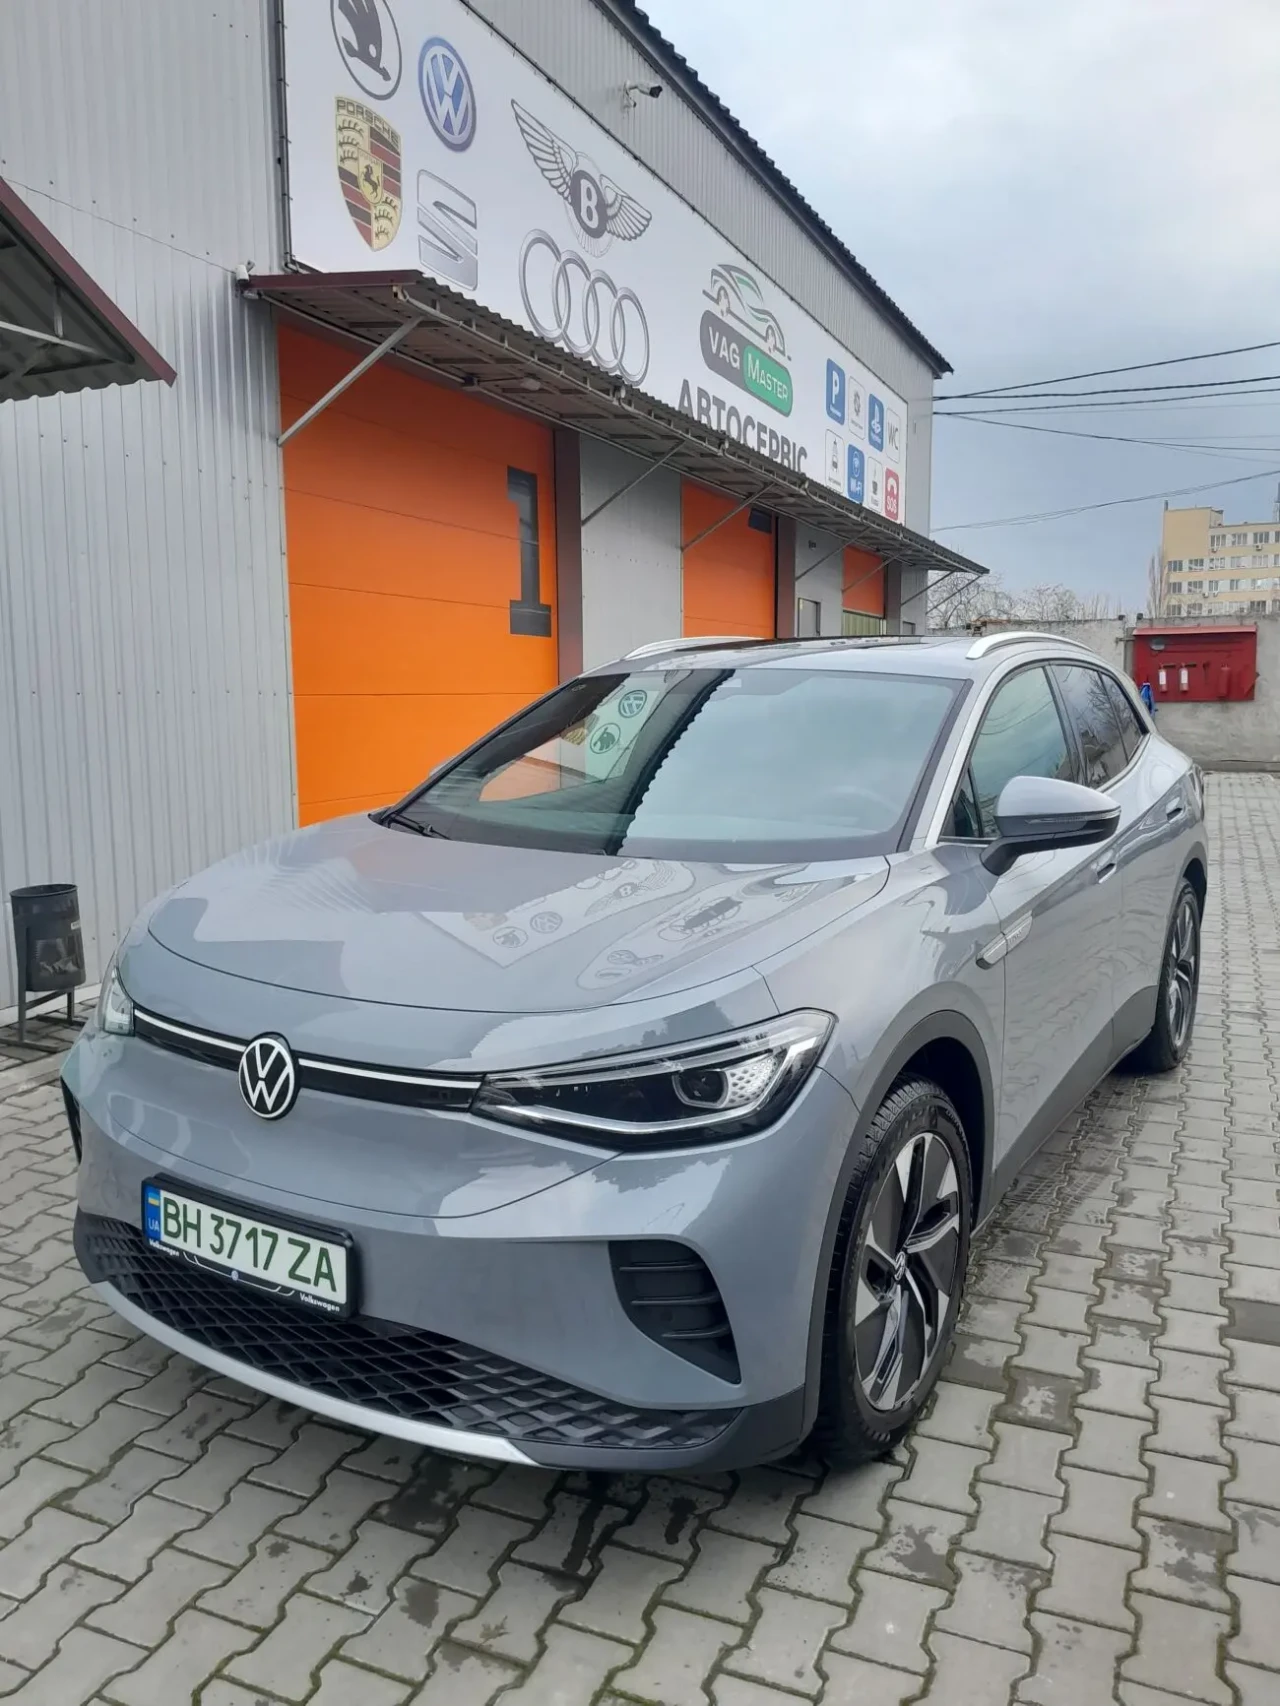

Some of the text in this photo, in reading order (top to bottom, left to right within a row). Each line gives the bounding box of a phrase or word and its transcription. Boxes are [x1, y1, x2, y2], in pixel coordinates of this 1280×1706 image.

[336, 98, 399, 148] PORSCHE
[708, 326, 740, 370] VAG
[832, 370, 840, 405] P
[888, 421, 899, 451] WC
[886, 495, 898, 514] SOS
[148, 1217, 160, 1231] UA
[163, 1196, 337, 1293] BH 3717 ZA
[300, 1292, 340, 1312] Volkswagen
